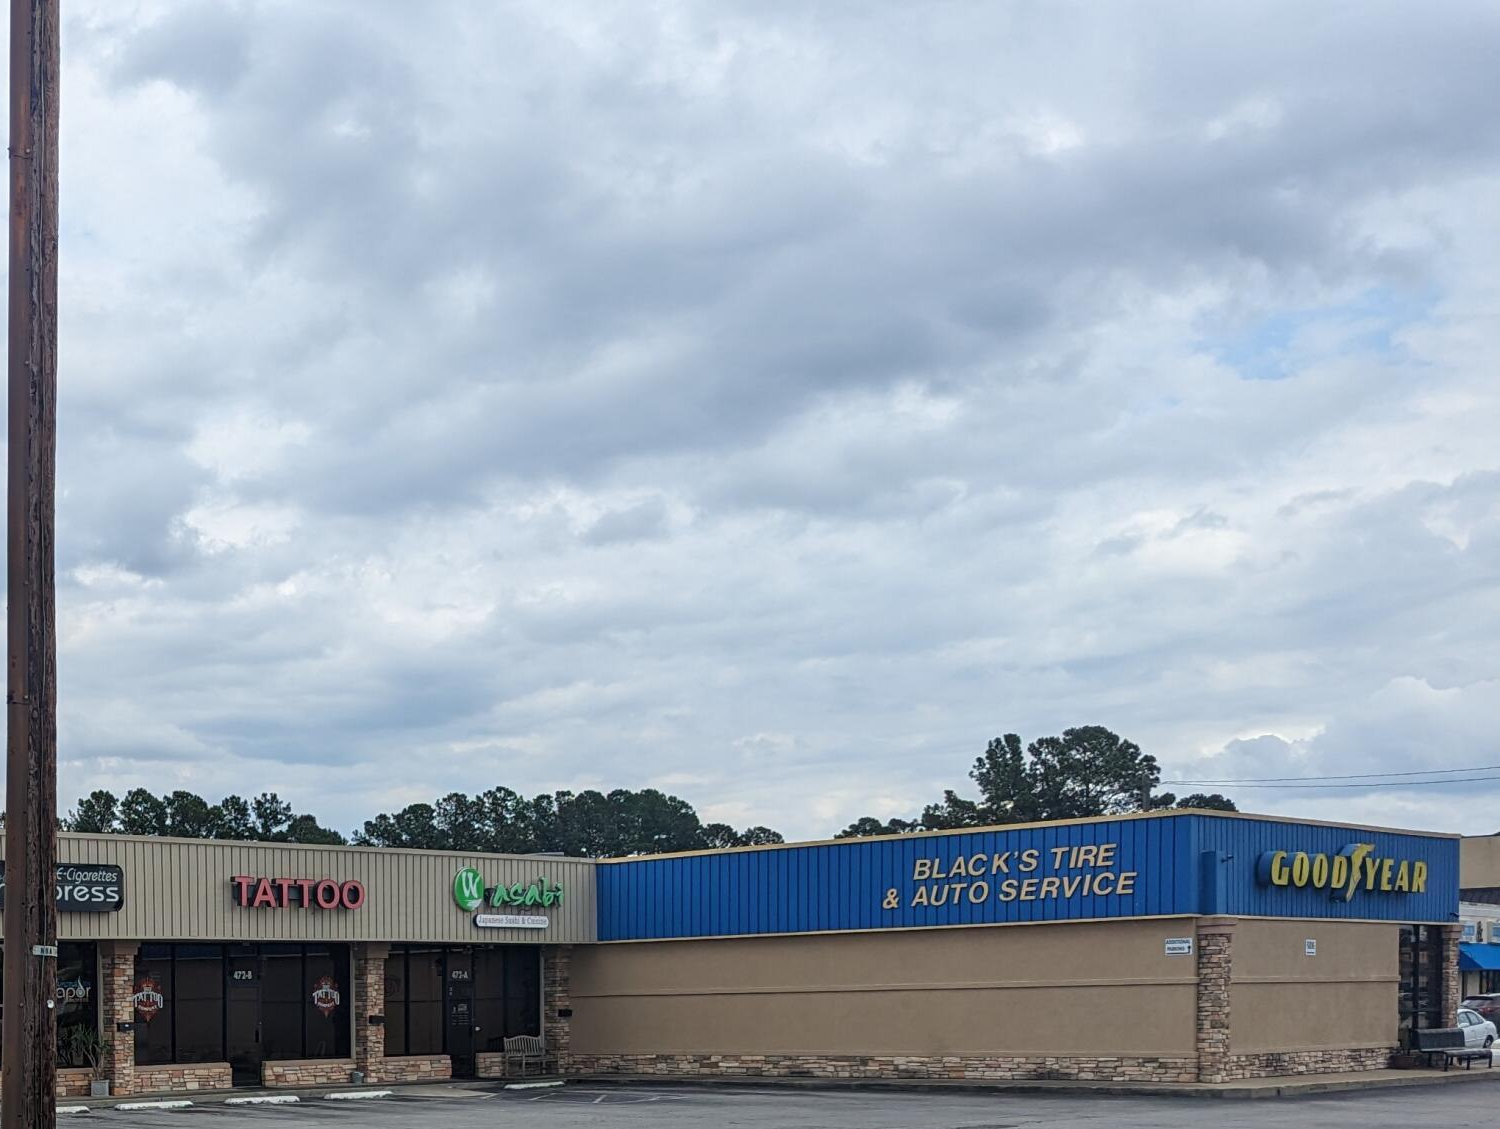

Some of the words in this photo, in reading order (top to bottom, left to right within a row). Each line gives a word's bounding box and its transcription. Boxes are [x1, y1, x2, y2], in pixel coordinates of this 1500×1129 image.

[56, 866, 118, 885] E-Cigarettes
[912, 848, 1040, 880] BLACK'S
[1050, 843, 1117, 869] TIRE
[1270, 848, 1428, 894] GOODYEAR
[233, 875, 365, 909] TATTOO
[882, 888, 900, 909] &
[911, 881, 990, 907] AUTO
[998, 871, 1139, 902] SERVICE
[57, 984, 92, 1001] apor
[312, 988, 340, 1005] TATTOO
